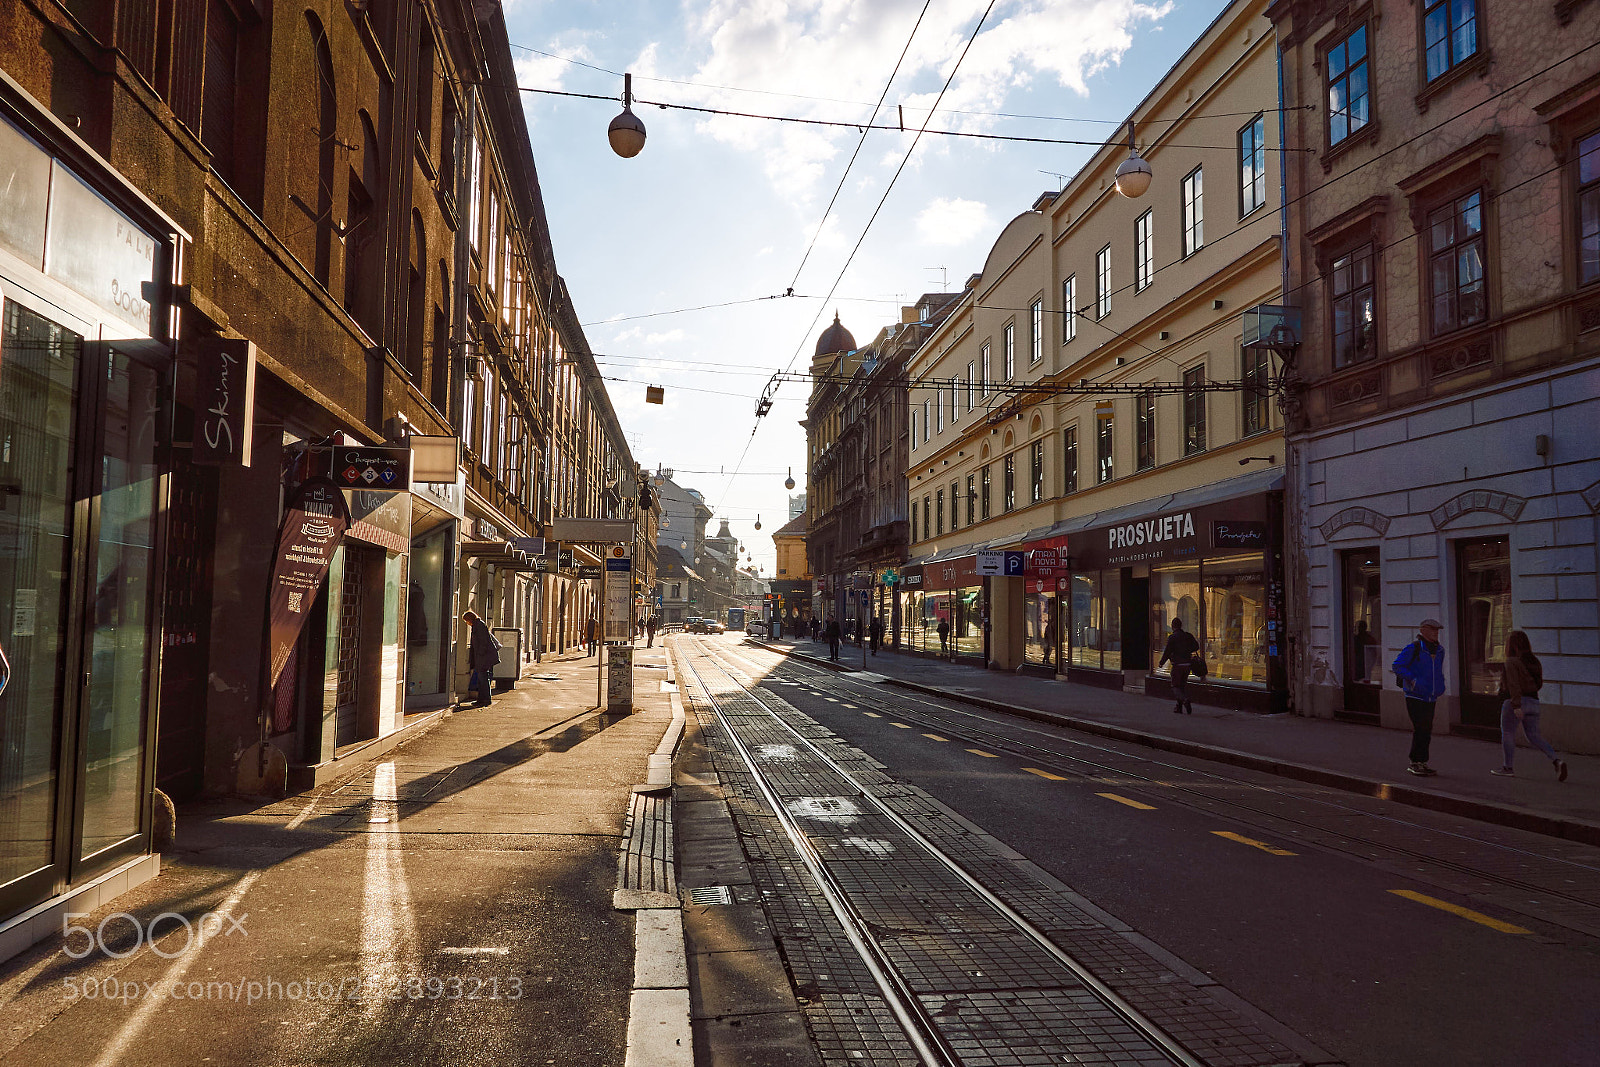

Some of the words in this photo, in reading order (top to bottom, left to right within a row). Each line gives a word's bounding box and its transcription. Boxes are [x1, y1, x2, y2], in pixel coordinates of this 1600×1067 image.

[203, 352, 239, 454] Skiny
[1108, 512, 1195, 550] PROSVJETA
[1034, 550, 1056, 558] MAXI
[1010, 559, 1019, 573] P
[1034, 558, 1056, 566] NOVA
